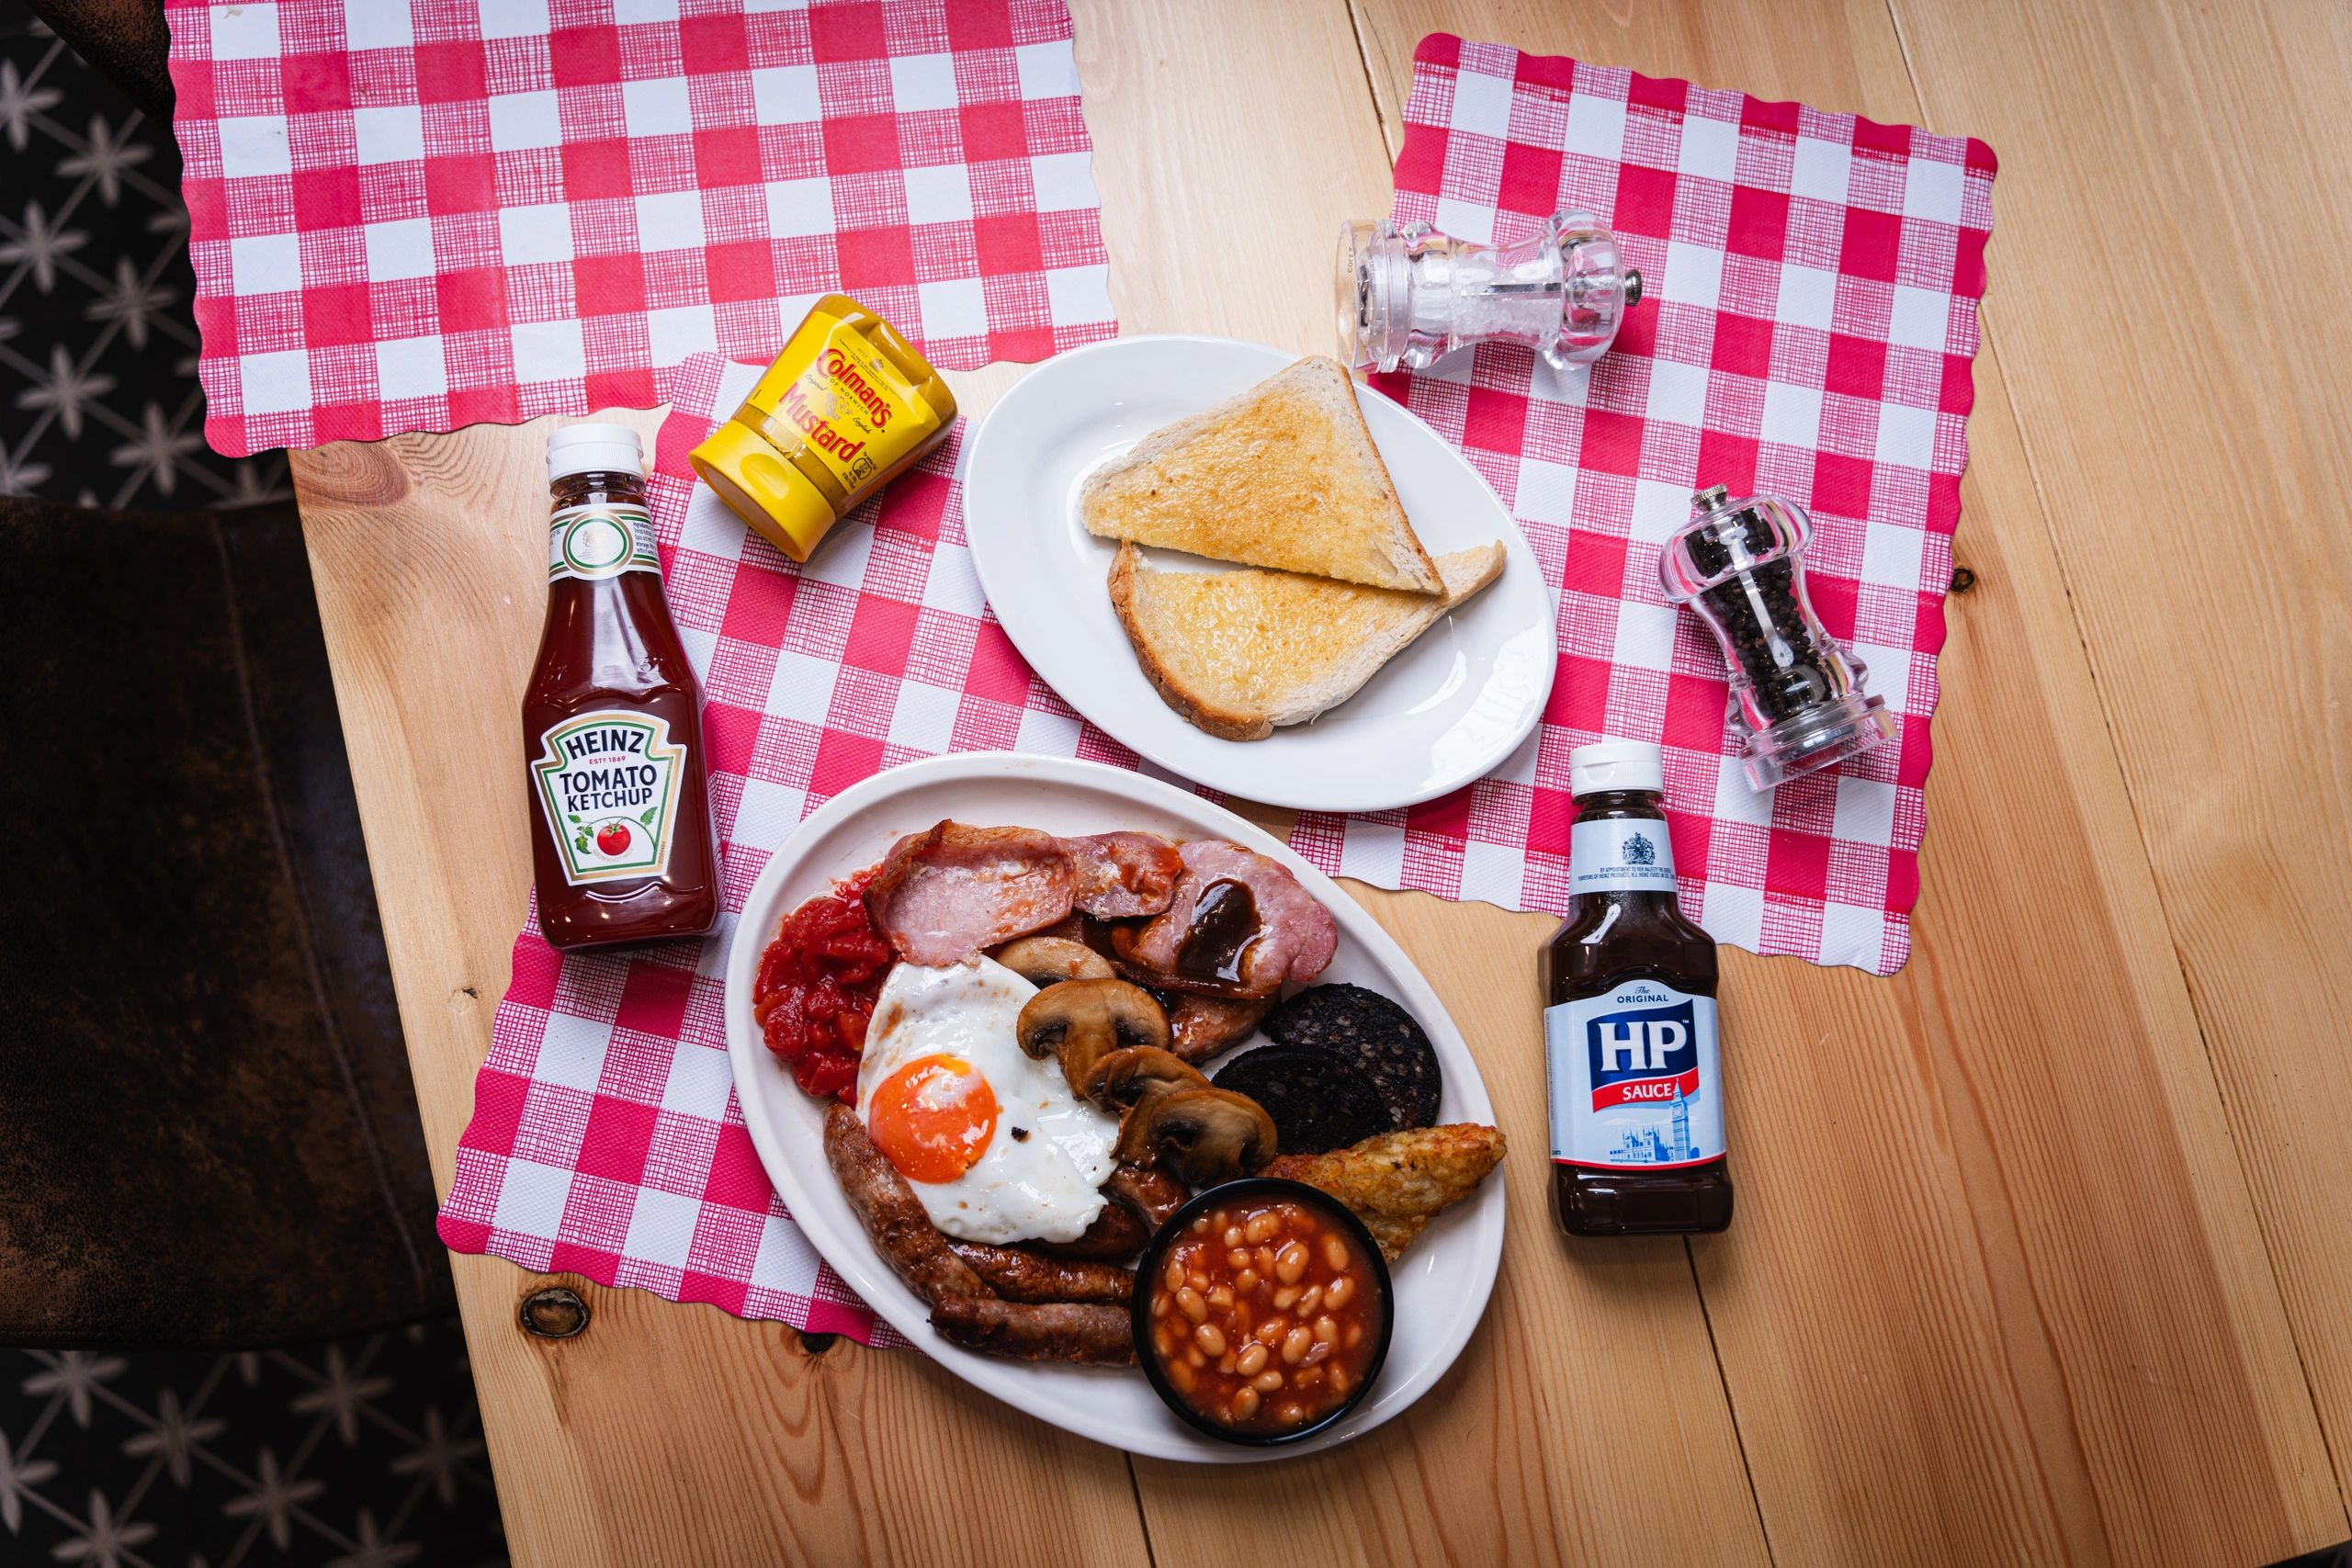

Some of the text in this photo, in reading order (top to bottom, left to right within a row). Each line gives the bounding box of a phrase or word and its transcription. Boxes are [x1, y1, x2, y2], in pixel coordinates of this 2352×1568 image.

[817, 348, 893, 430] Colman's
[830, 378, 838, 387] OF
[840, 387, 869, 415] NORWICH
[779, 381, 866, 463] Mustard
[565, 729, 645, 761] HEINZ
[559, 764, 657, 795] TOMATO
[567, 787, 653, 813] KETCHUP
[1617, 994, 1669, 1004] ORIGINAL
[1634, 986, 1650, 995] The
[1598, 1020, 1688, 1072] HP
[1623, 1082, 1674, 1101] SAUCE
